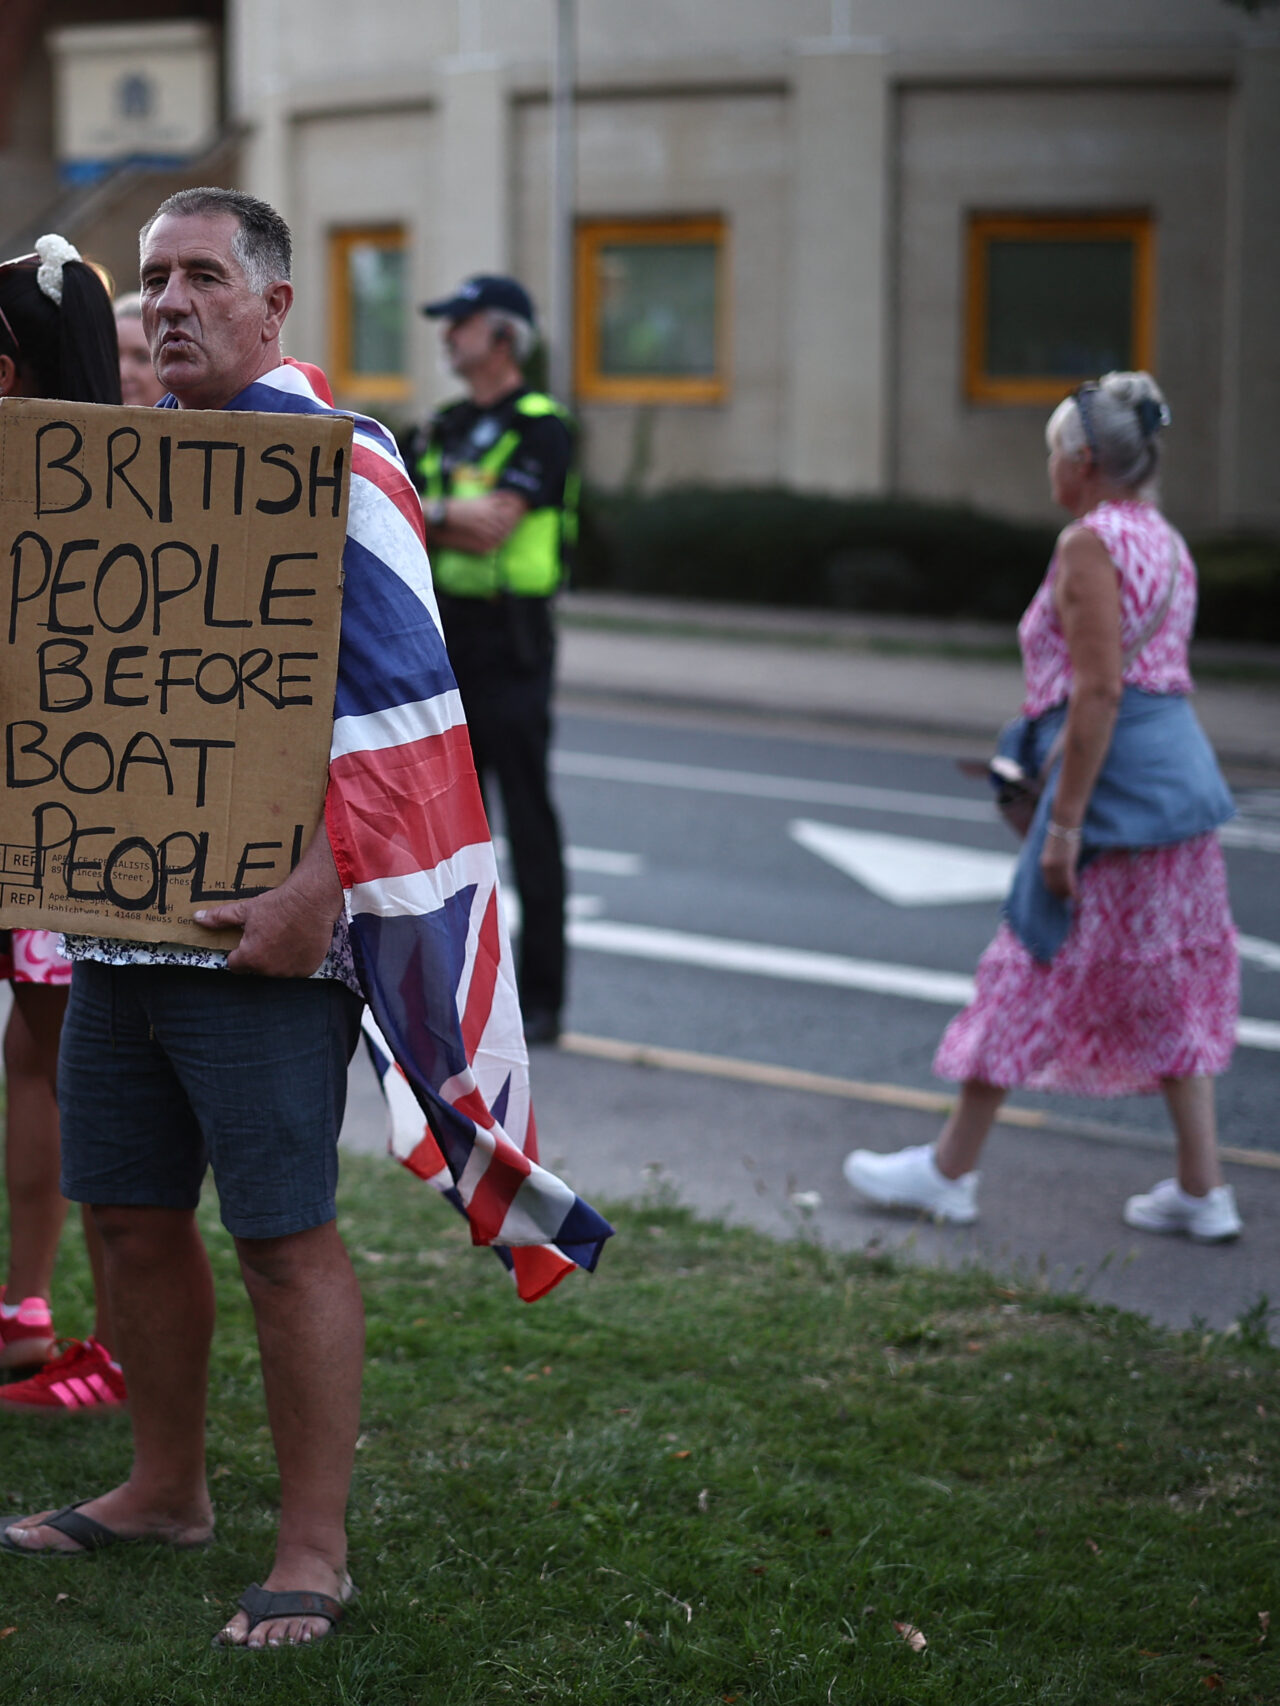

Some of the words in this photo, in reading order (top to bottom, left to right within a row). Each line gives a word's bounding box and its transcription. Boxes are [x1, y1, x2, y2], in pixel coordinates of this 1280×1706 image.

[34, 421, 344, 522] BRITISH
[9, 530, 318, 645] PEOPLE
[37, 638, 318, 715] BEFORE
[6, 720, 236, 807] BOAT
[10, 892, 35, 906] REP
[32, 801, 304, 915] PEOPLE!
[52, 853, 72, 864] APE
[114, 911, 141, 920] 41468
